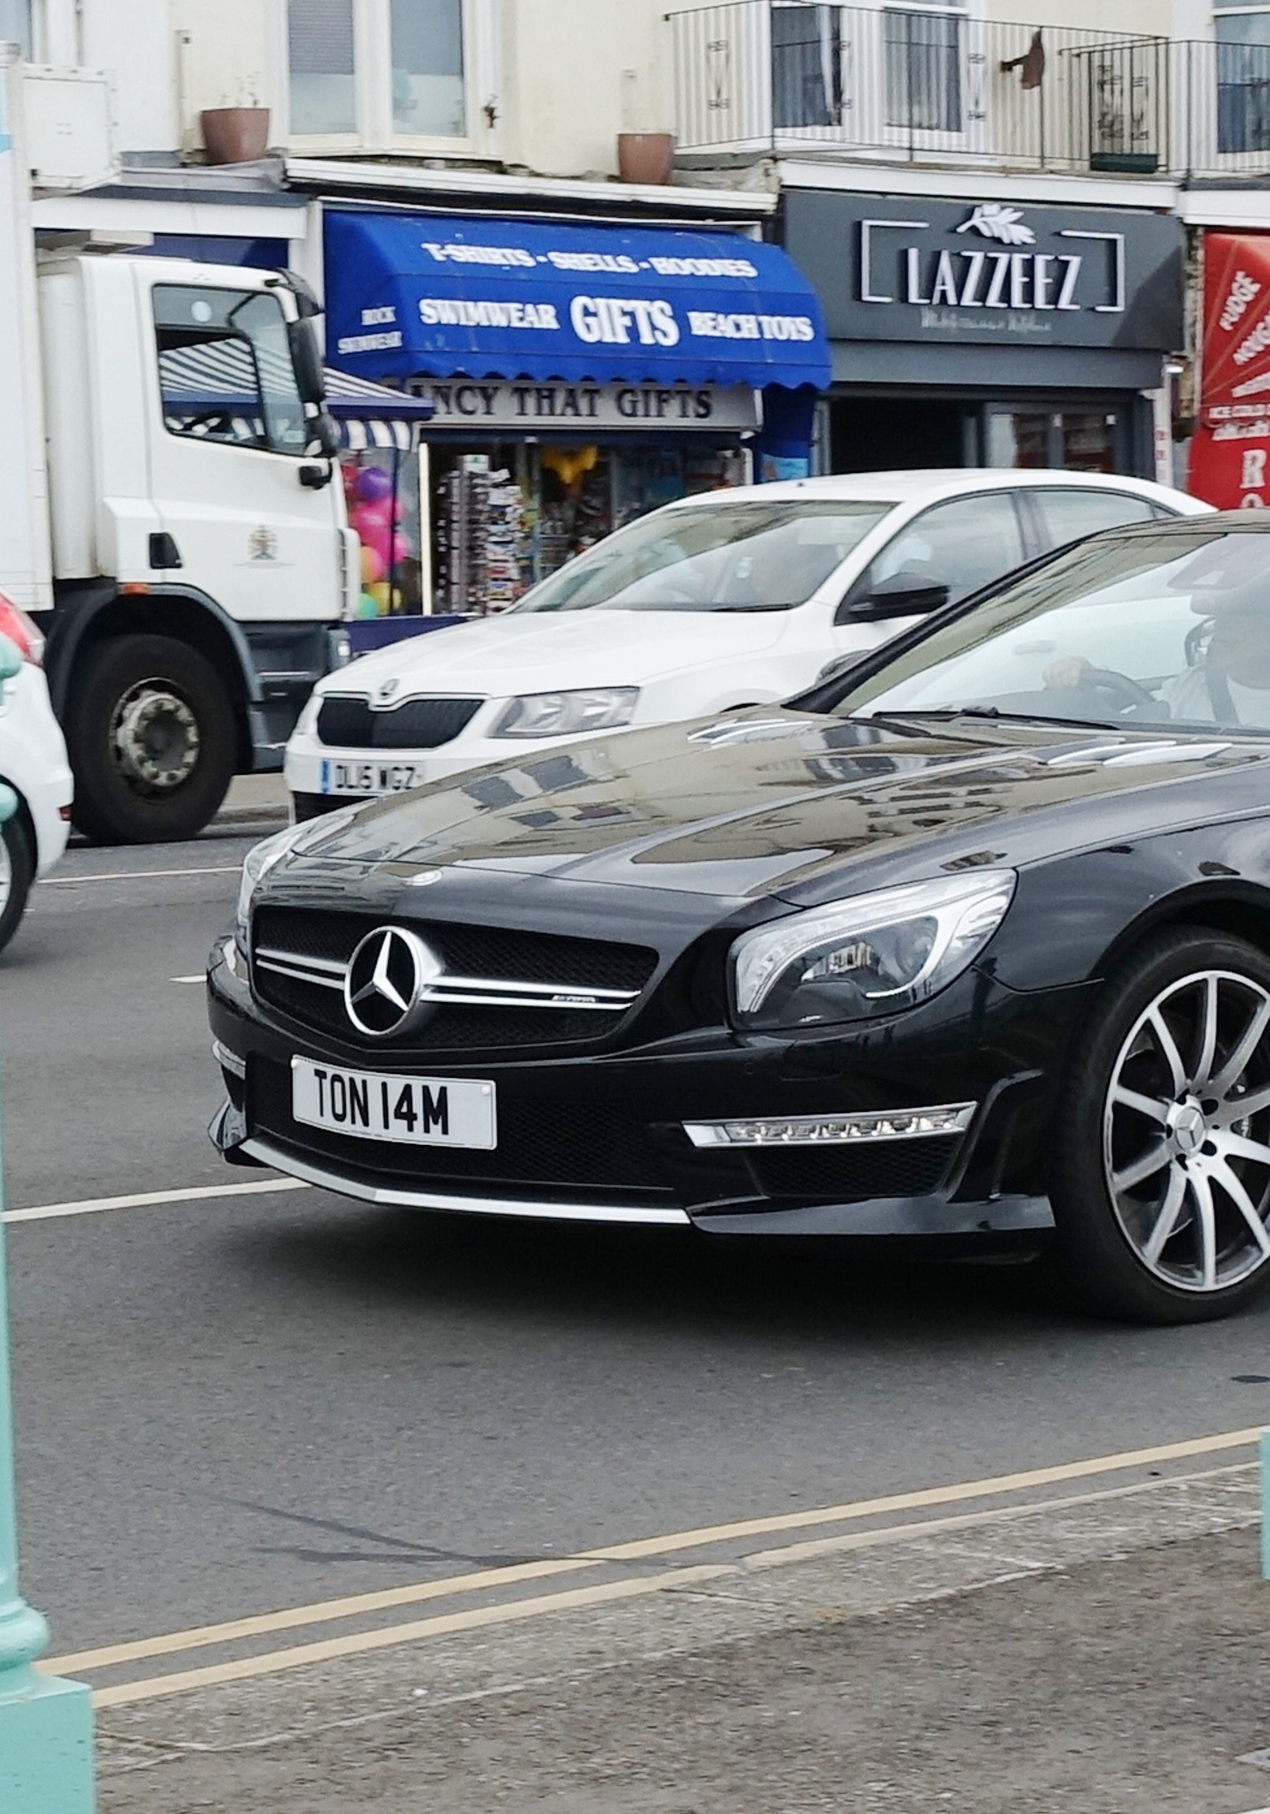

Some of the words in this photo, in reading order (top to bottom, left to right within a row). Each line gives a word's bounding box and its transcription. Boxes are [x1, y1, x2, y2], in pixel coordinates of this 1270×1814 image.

[421, 242, 536, 268] T-SHIRTS
[547, 251, 639, 274] SHELLS
[649, 257, 759, 278] HOODIES
[907, 247, 1082, 310] LAZZEEZ
[419, 299, 561, 330] SWIMWEAR
[570, 295, 680, 347] GIFTS
[687, 310, 761, 339] BEACH
[757, 315, 815, 342] TOYS
[1218, 269, 1262, 332] FUDGE
[510, 388, 602, 418] THAT
[614, 388, 713, 419] GIFTS
[314, 1068, 370, 1127] TON
[381, 1081, 450, 1136] 14M
